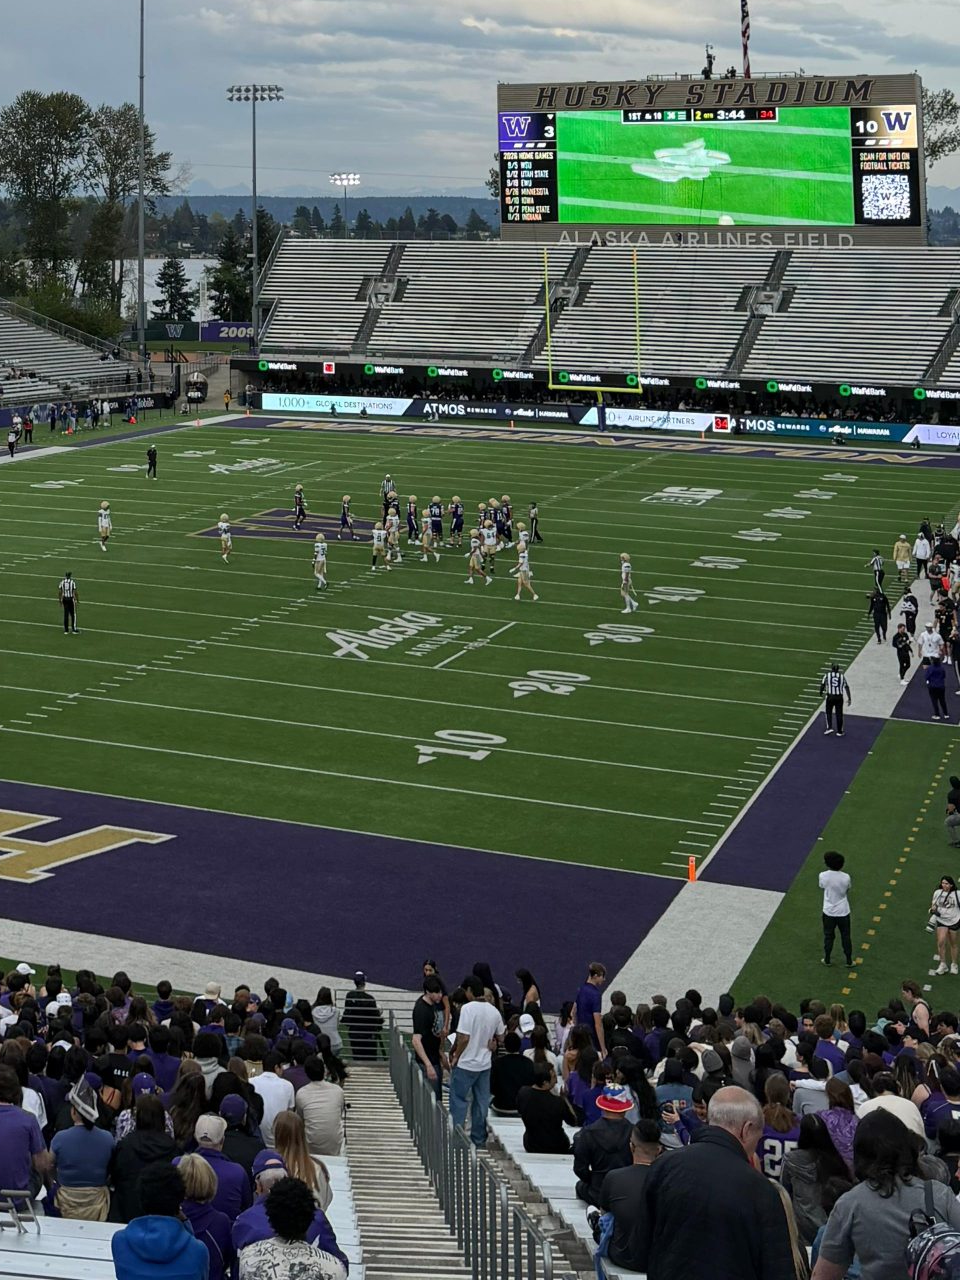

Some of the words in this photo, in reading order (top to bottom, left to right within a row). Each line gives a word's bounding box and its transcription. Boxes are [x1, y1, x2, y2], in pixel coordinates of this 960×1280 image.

[533, 84, 665, 109] HUSKY
[685, 79, 875, 107] STADIUM
[628, 112, 641, 120] 1ST
[717, 110, 745, 120] 3:44
[760, 110, 773, 118] 34
[502, 116, 531, 137] W
[856, 121, 878, 133] 10
[881, 111, 911, 132] W
[544, 126, 554, 138] 3
[860, 152, 874, 160] SCAN
[876, 152, 886, 160] FOR
[888, 152, 901, 160] INFO
[901, 152, 910, 160] ON
[860, 162, 887, 170] FOOTBALL
[888, 161, 910, 170] TICKETS
[534, 170, 549, 178] STATE
[521, 188, 549, 196] MINNESOTA
[521, 205, 535, 213] PENN
[536, 205, 550, 213] STATE
[522, 213, 542, 221] INDIANA
[558, 230, 650, 247] ALASKA
[661, 231, 774, 248] AIRLINES
[784, 232, 855, 249] FIELD
[165, 324, 184, 338] W
[218, 326, 254, 338] 2009
[278, 397, 311, 408] 1,000+
[315, 400, 342, 408] GLOBAL
[344, 401, 393, 410] DESTINATIONS
[423, 403, 466, 415] ATMOS
[628, 414, 655, 422] AIRLINE
[715, 417, 728, 429] 34
[730, 418, 776, 432] ATMOS
[643, 586, 706, 602] 40
[325, 610, 444, 660] Alaska
[405, 625, 473, 656] AIRLINES
[583, 623, 655, 643] 30
[508, 670, 591, 696] 20
[831, 677, 839, 687] S
[414, 729, 507, 761] 10
